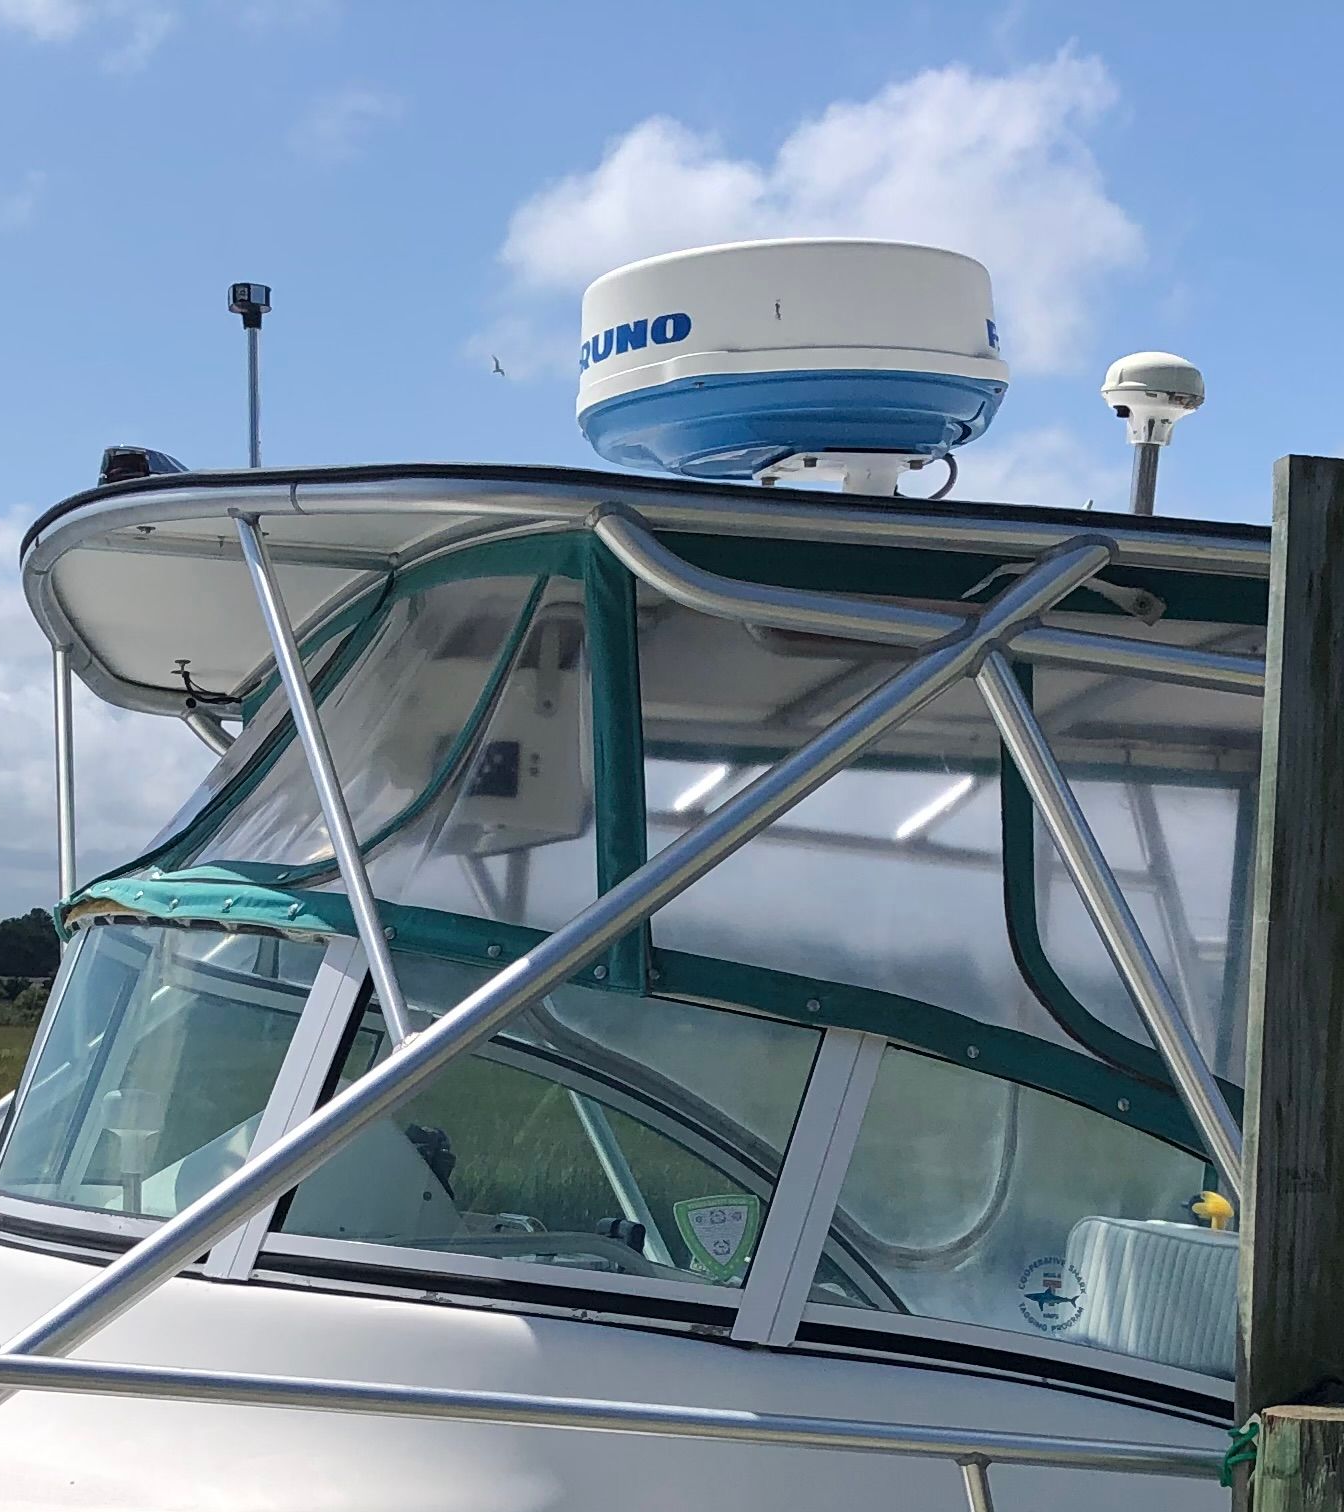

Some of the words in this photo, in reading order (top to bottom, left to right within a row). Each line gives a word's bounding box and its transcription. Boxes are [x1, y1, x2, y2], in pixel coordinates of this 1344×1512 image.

[1018, 1256, 1066, 1290] COOPERATIVE
[1068, 1264, 1087, 1295] SHARK
[1017, 1302, 1048, 1332] TAGGING
[1050, 1306, 1085, 1332] PROGRAM
